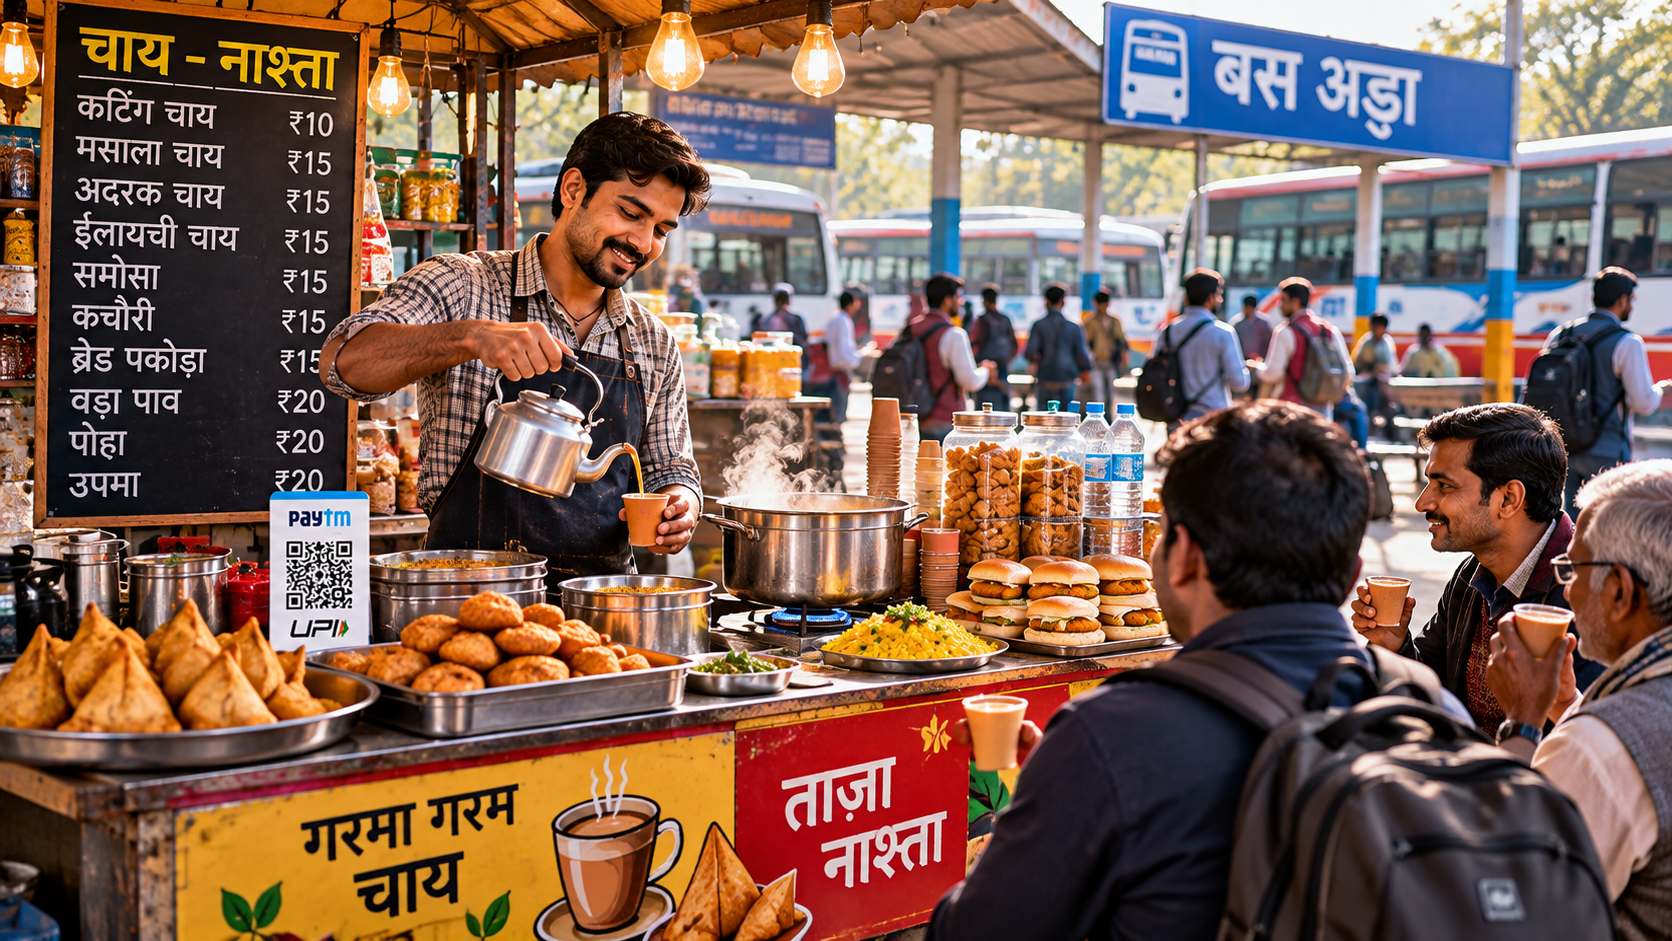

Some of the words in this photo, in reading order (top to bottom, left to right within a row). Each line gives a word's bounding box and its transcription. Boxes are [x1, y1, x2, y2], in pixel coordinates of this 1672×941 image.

[80, 27, 175, 76] चाय
[186, 56, 205, 64] -
[218, 41, 340, 91] नाश्ता
[1212, 40, 1303, 110] बस
[77, 88, 154, 124] कटिंग
[164, 102, 217, 129] चाय
[290, 111, 333, 136] ₹10
[76, 136, 163, 165] मसाला
[173, 143, 225, 168] चाय
[288, 150, 331, 175] ₹15
[75, 178, 163, 206] अदरक
[173, 183, 225, 209] चाय
[287, 189, 329, 214] ₹15
[73, 211, 178, 250] ईलायची
[188, 226, 239, 251] चाय
[285, 230, 328, 254] ₹15
[73, 254, 160, 289] समोसा
[284, 270, 327, 293] ₹15
[72, 295, 155, 331] कचौरी
[282, 310, 325, 333] ₹15
[71, 337, 114, 373] ब्रेड
[124, 339, 207, 378] पकोड़ा
[280, 350, 321, 373] ₹15
[70, 389, 122, 419] वड़ा
[132, 390, 182, 414] पाव
[278, 389, 325, 413] ₹20
[69, 422, 127, 460] पोहा
[276, 430, 324, 453] ₹20
[69, 473, 141, 497] उपमा
[275, 469, 323, 491] ₹20
[291, 620, 339, 637] UPI
[782, 756, 896, 832] ताज़ा
[301, 802, 416, 861] गरमा
[428, 784, 518, 836] गरम
[821, 811, 947, 888] नाश्ता
[353, 851, 464, 917] चाय
